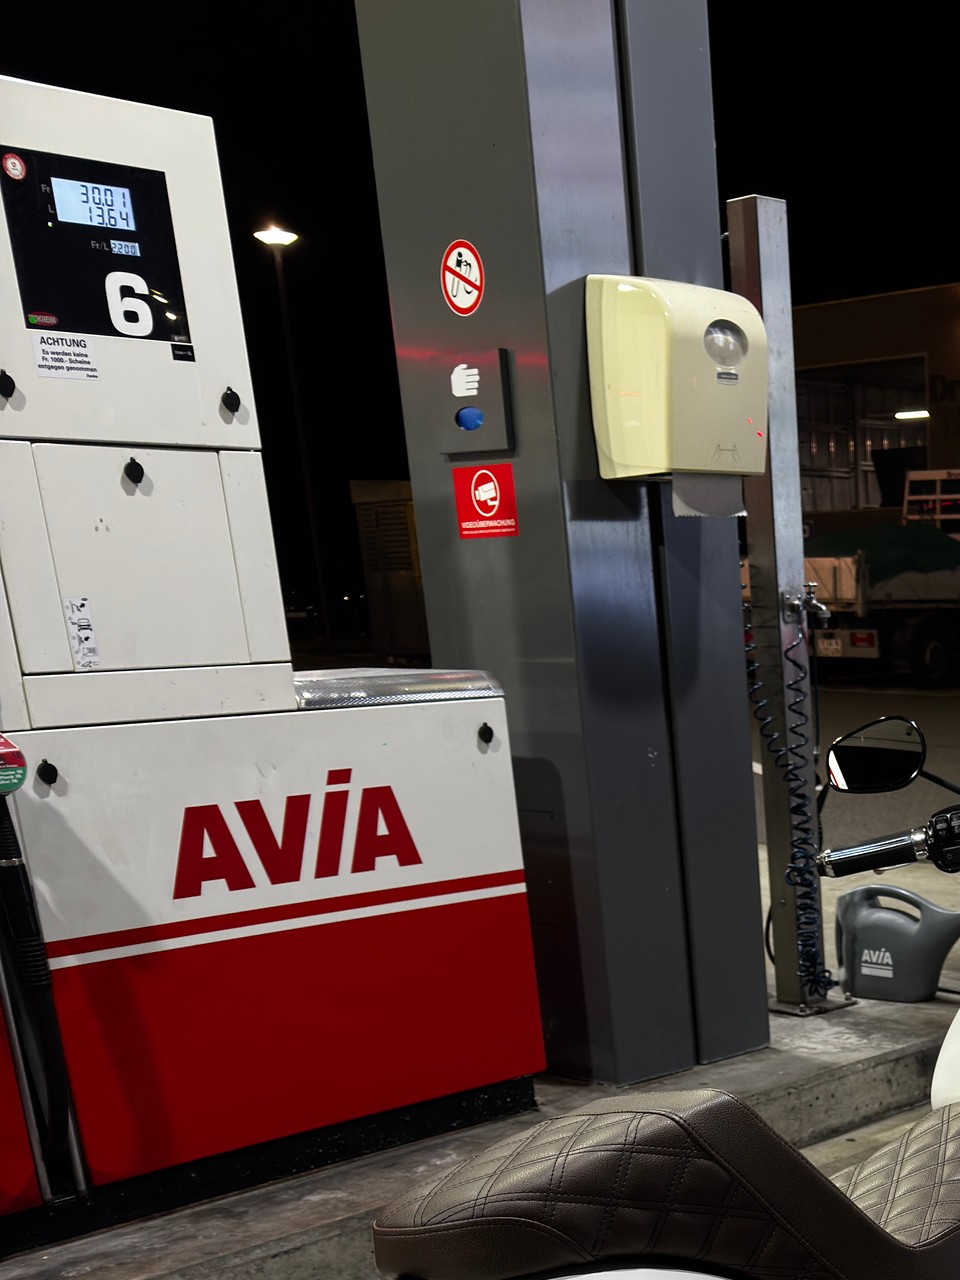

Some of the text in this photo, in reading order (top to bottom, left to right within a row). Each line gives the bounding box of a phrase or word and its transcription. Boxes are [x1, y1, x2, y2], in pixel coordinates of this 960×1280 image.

[80, 184, 127, 208] 30.01
[89, 207, 129, 227] 13.64
[104, 271, 153, 336] 6
[40, 336, 87, 348] ACHTUNG
